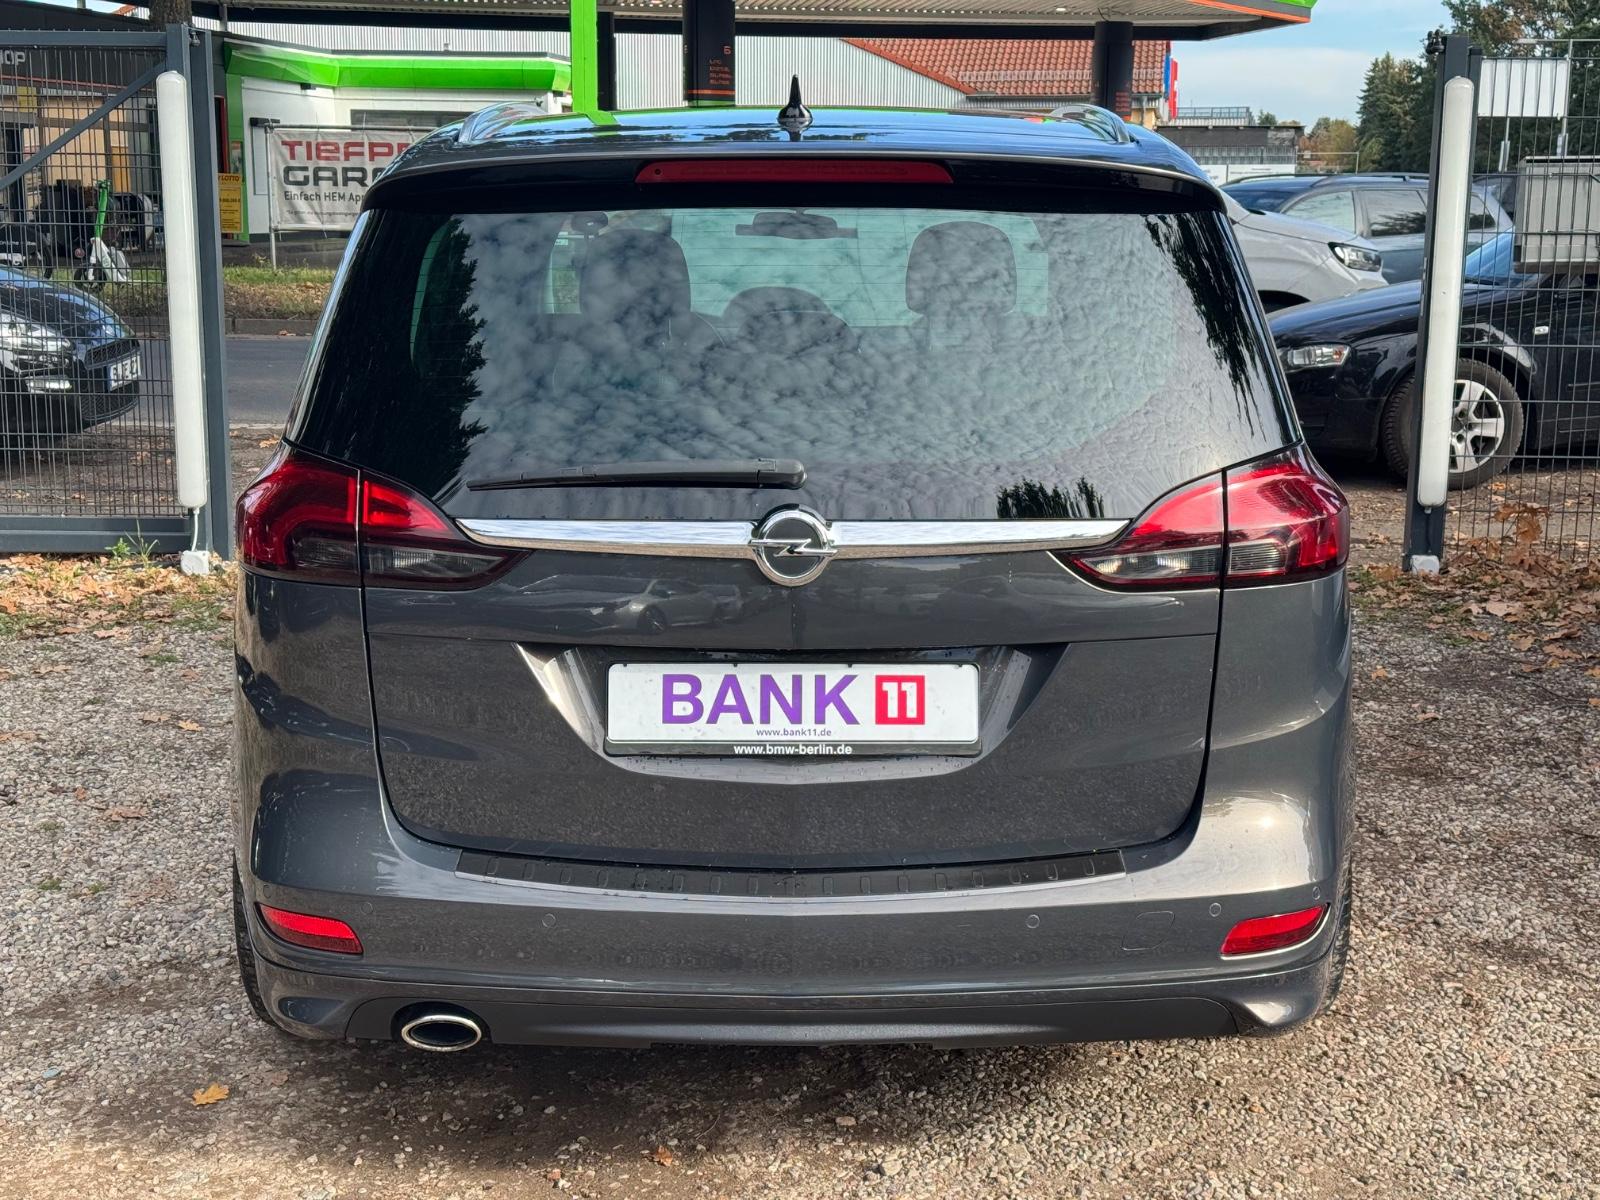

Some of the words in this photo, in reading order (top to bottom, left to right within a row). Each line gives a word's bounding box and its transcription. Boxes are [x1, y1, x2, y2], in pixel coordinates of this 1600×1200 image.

[0, 49, 26, 65] OP
[284, 190, 321, 201] Einfach
[324, 191, 346, 202] HEM
[661, 674, 860, 725] BANK
[880, 680, 919, 720] 11
[756, 728, 832, 737] www.bank11.de
[733, 744, 853, 755] www.bmw-berlin.de
